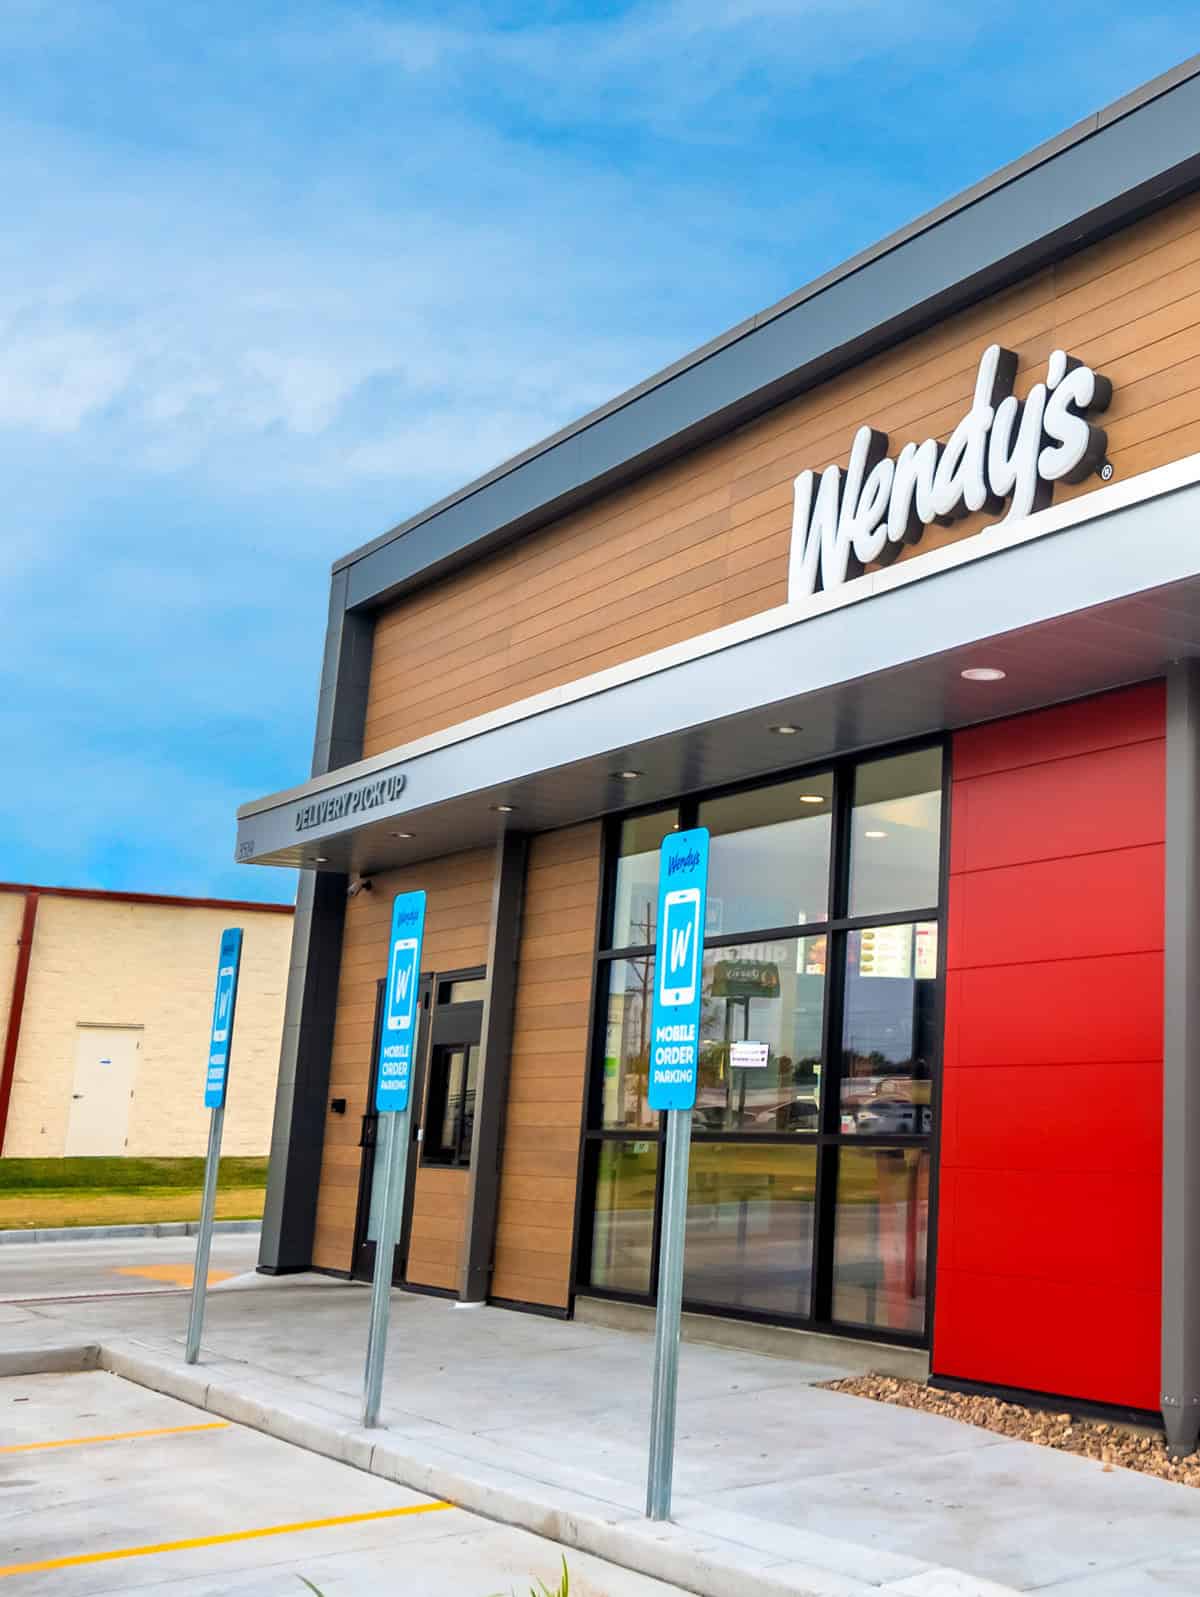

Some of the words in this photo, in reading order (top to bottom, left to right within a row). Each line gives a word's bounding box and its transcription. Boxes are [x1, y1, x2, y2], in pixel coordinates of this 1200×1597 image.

[788, 344, 1103, 604] Wendy's
[296, 791, 352, 831] DELIVERY
[352, 779, 387, 813] PICK
[386, 774, 407, 802] UP
[670, 920, 693, 974] W
[395, 964, 412, 1004] W
[656, 1024, 695, 1043] MOBILE
[655, 1046, 694, 1066] ORDER
[654, 1069, 693, 1084] PARKING
